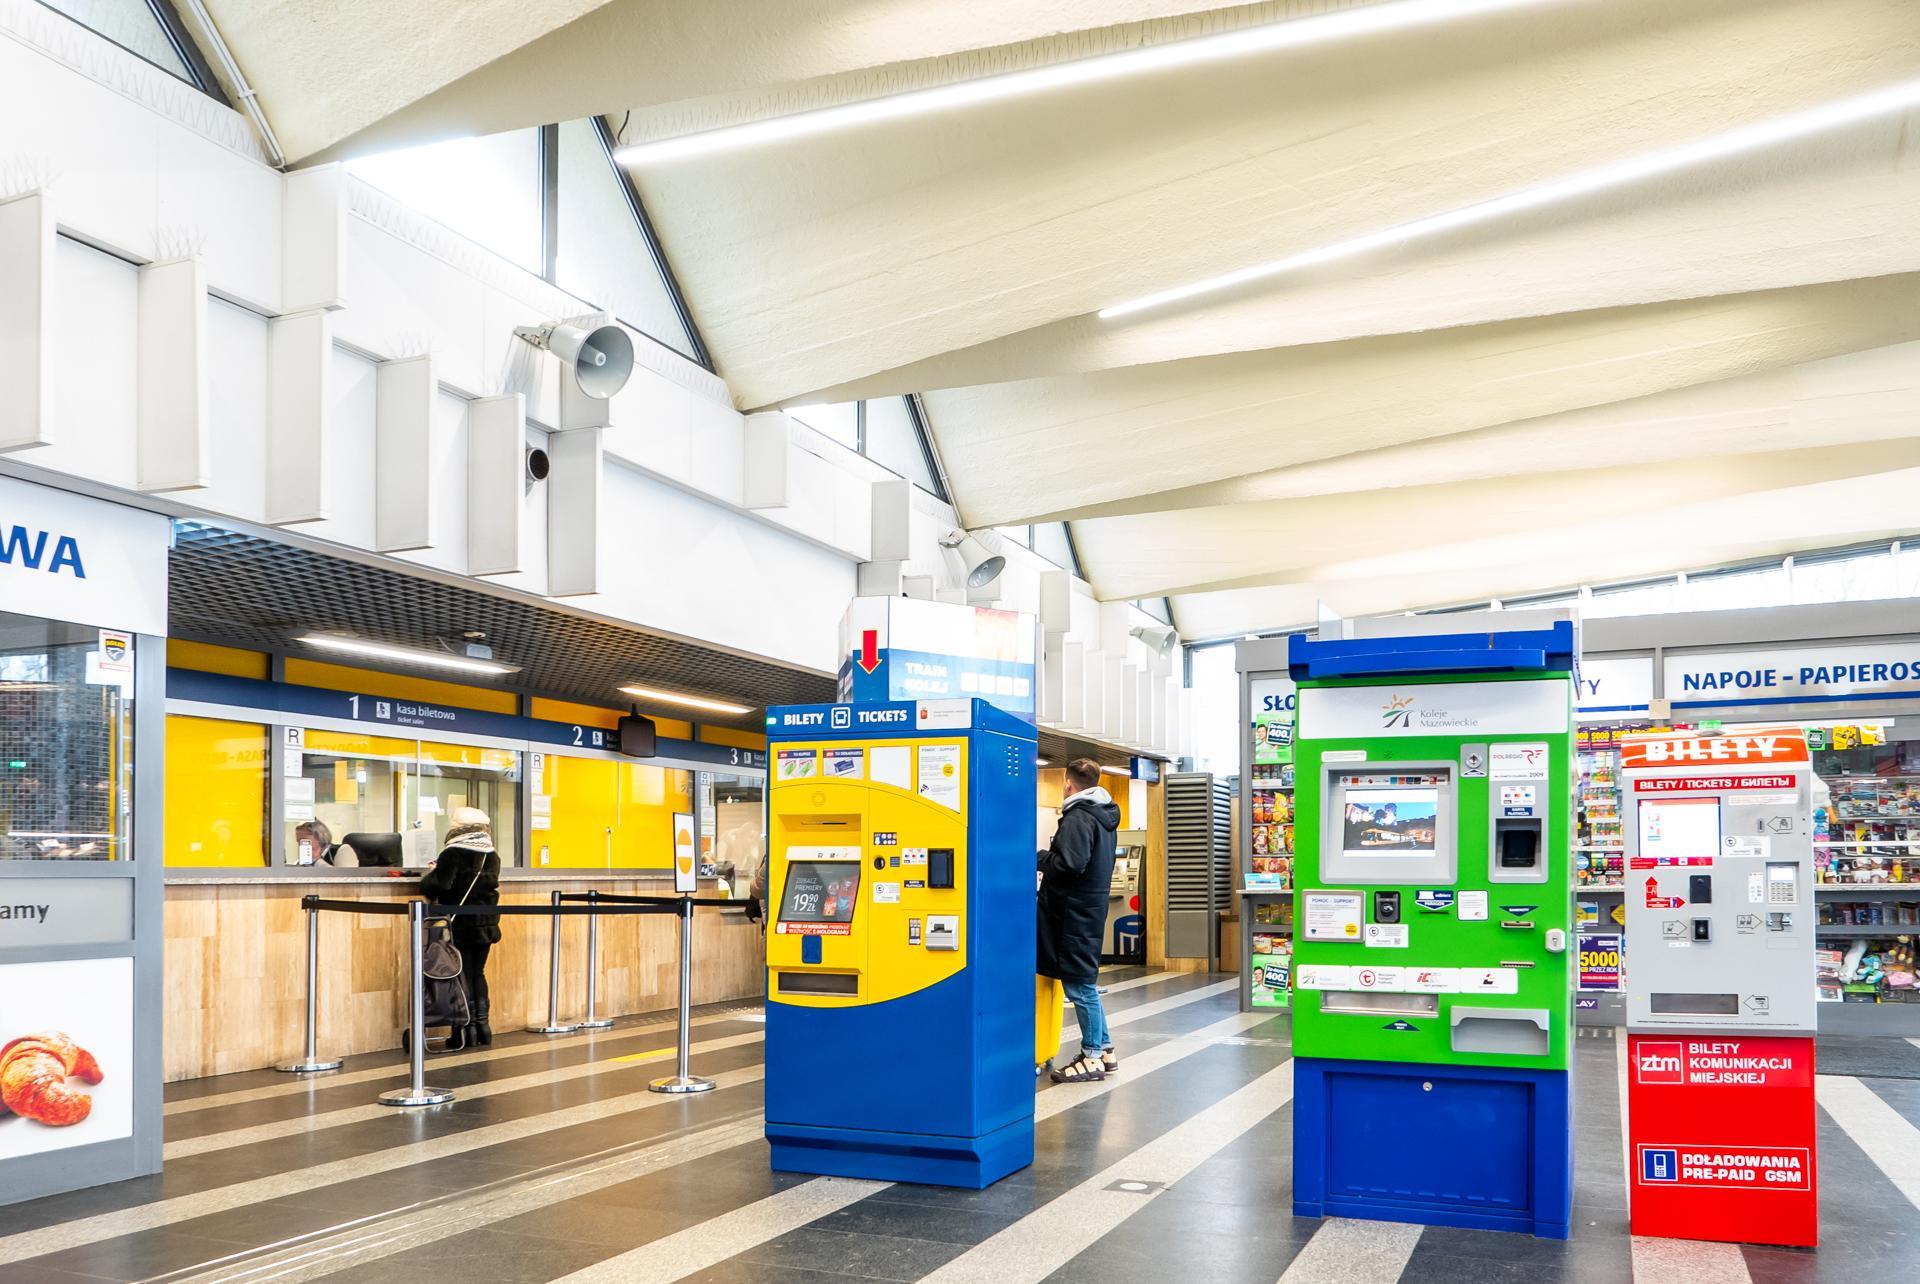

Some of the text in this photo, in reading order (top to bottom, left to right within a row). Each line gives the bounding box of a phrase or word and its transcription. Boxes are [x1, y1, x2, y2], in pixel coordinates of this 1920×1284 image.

[0, 520, 86, 579] WA
[1684, 669, 1777, 690] NAPOJE
[348, 695, 359, 719] 1
[396, 703, 456, 721] kasa biletowa
[1420, 709, 1448, 719] Koleje
[784, 710, 907, 725] BILETY TICKETS
[1420, 719, 1478, 728] Mazowieckie
[288, 729, 299, 743] R
[572, 726, 583, 746] 2
[730, 748, 738, 765] 3
[1646, 738, 1776, 761] BILETY
[534, 755, 542, 768] R
[1640, 781, 1677, 790] BILETY
[1686, 779, 1732, 788] TICKETS
[1741, 778, 1790, 787] БИЛЕТЫ
[793, 894, 818, 911] 19 90
[1580, 951, 1618, 967] 5000
[1266, 972, 1284, 981] 400
[1689, 1043, 1740, 1054] BILETY
[1641, 1055, 1680, 1071] ztm
[1690, 1058, 1792, 1069] KOMUNIKACJI
[1690, 1072, 1765, 1084] MIEJSKIEJ
[1682, 1154, 1800, 1169] DOŁADOWANIA
[1683, 1168, 1801, 1182] PRE-PAID GSM
